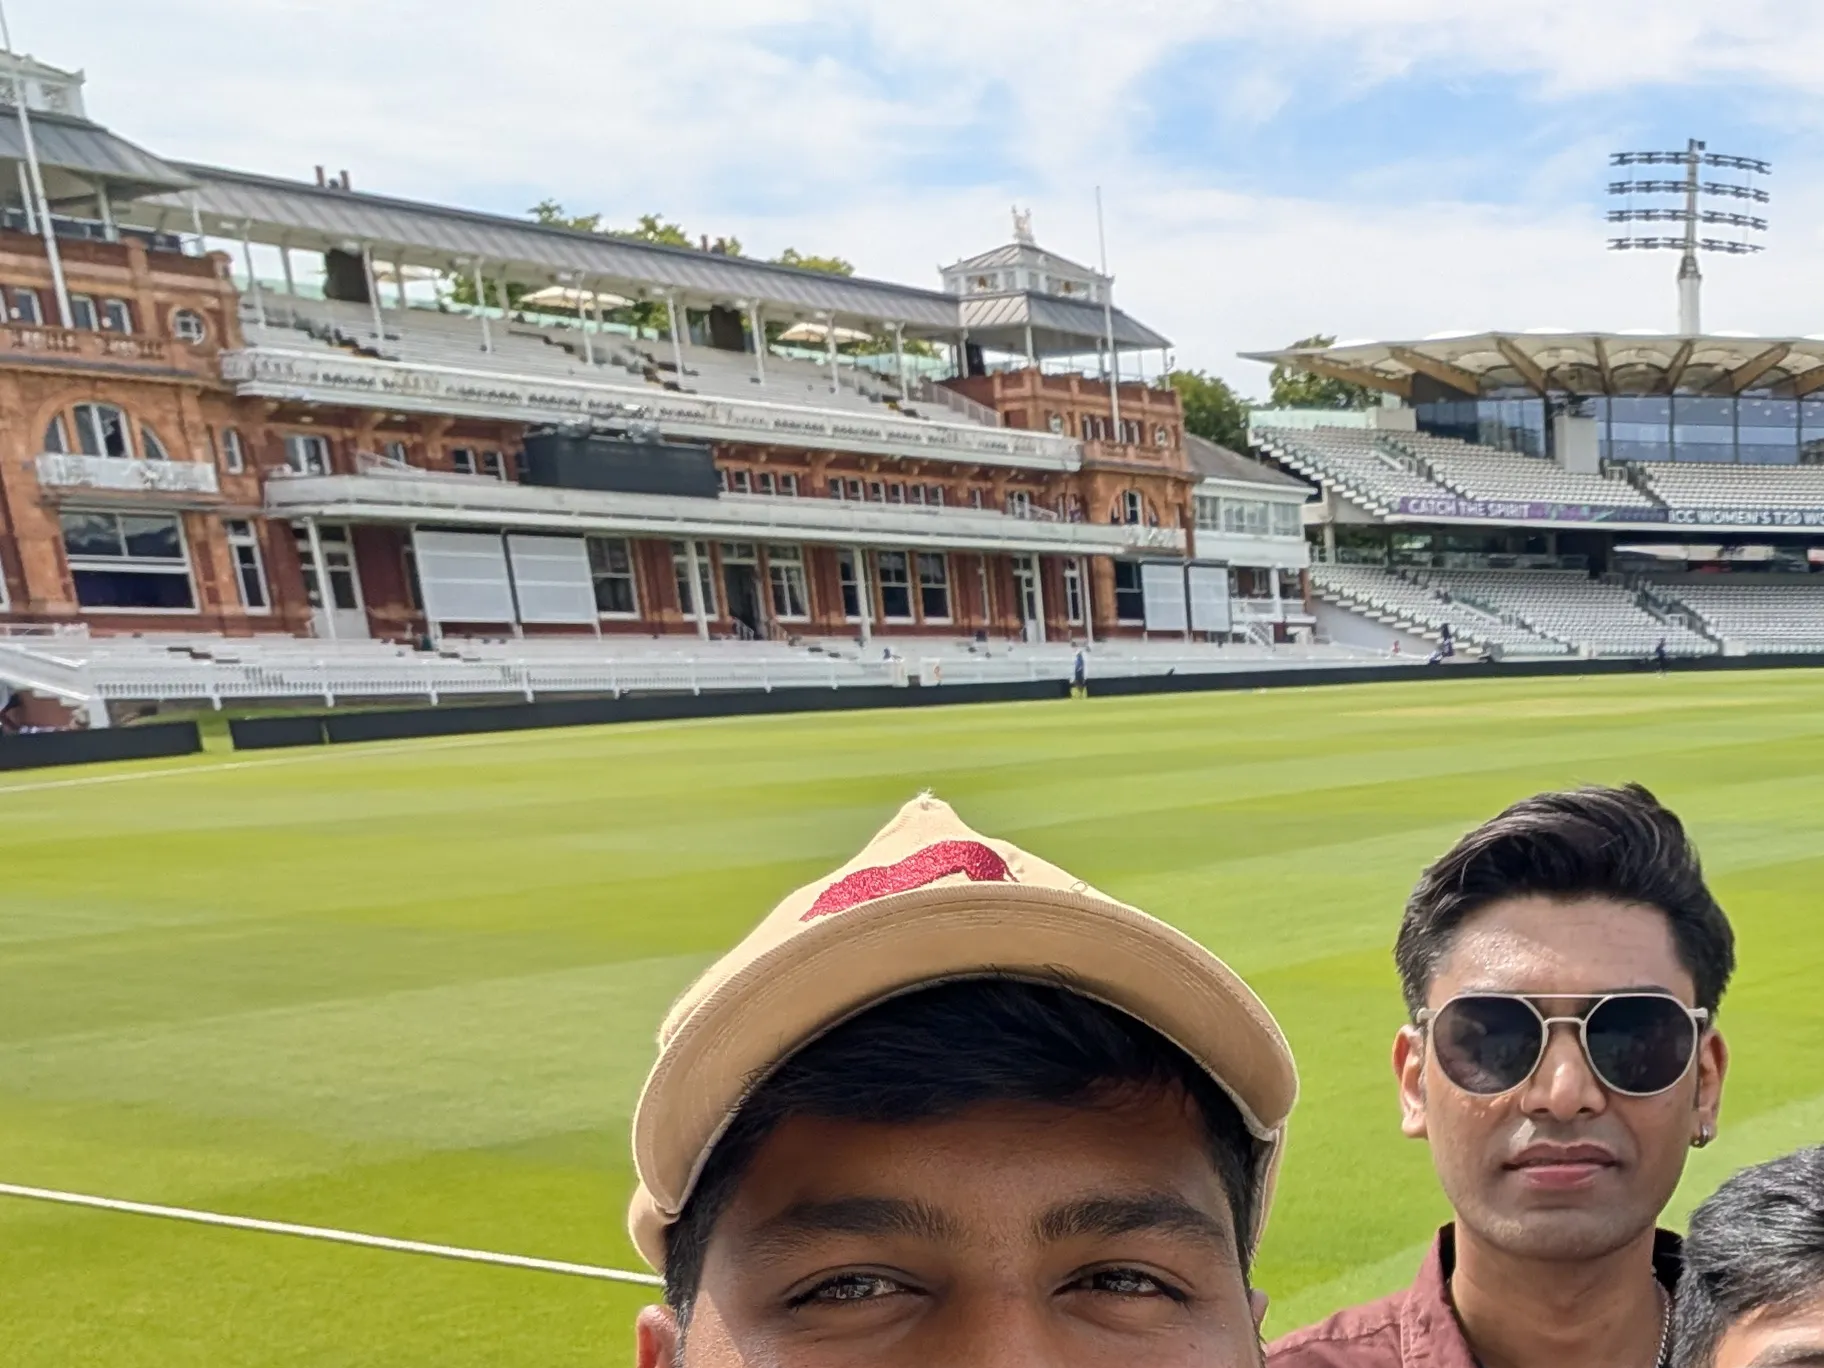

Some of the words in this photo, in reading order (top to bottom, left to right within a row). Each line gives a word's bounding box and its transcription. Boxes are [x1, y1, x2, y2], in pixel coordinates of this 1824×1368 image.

[1408, 499, 1457, 516] CATCH
[1458, 501, 1486, 517] THE
[1487, 502, 1531, 519] SPIRIT
[1668, 510, 1696, 524] ICC
[1697, 510, 1771, 524] WOMEN'S
[1774, 511, 1802, 525] T20
